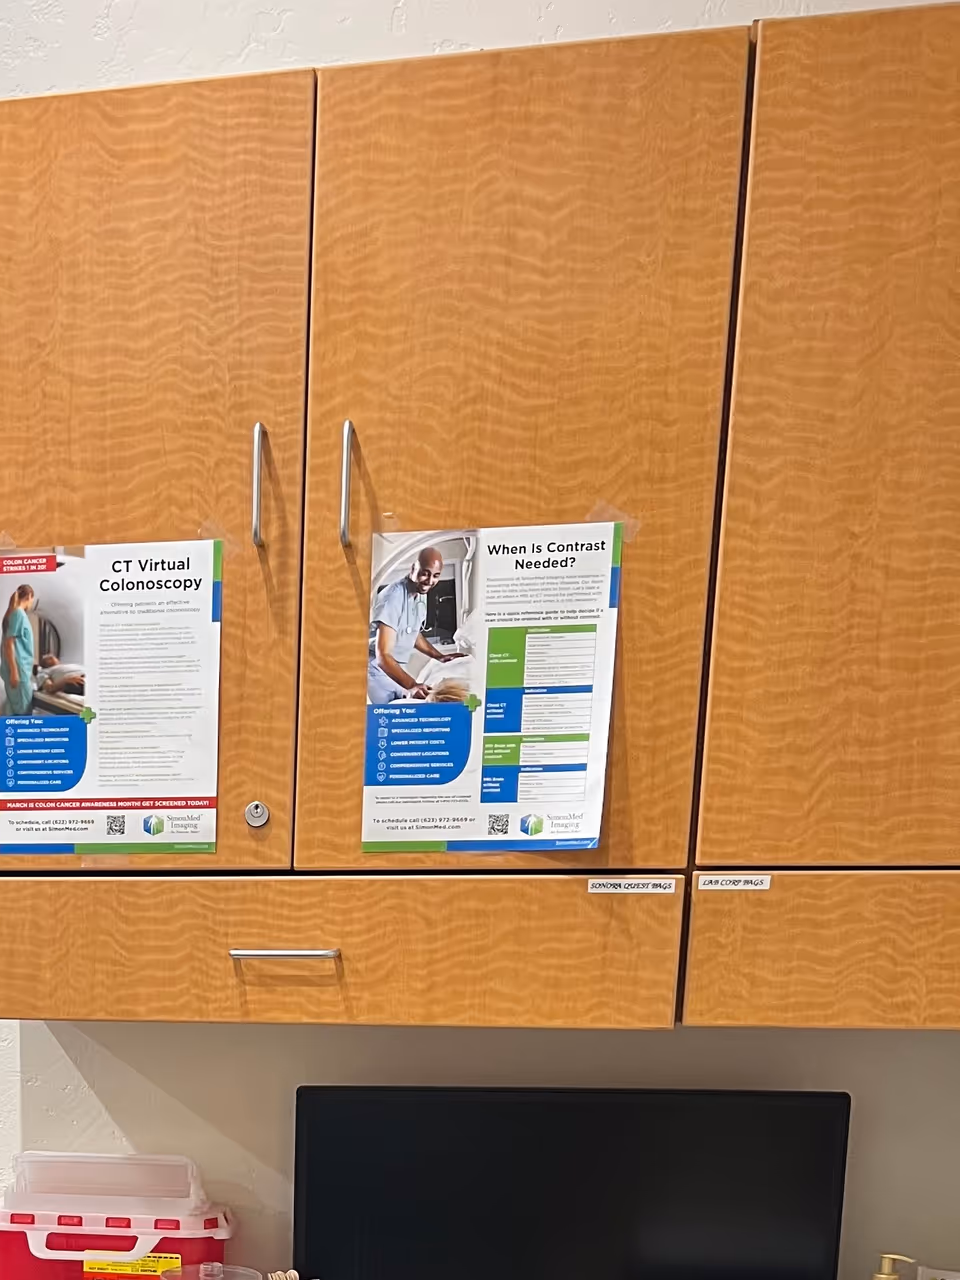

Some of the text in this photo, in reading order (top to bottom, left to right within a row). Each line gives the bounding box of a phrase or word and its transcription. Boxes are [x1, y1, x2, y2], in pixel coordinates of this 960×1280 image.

[488, 540, 606, 555] When Is Contrast
[112, 557, 190, 573] CT Virtual
[515, 557, 576, 570] Needed?
[100, 578, 202, 592] Colonoscopy
[590, 882, 672, 890] SONORA QUEST BAGS
